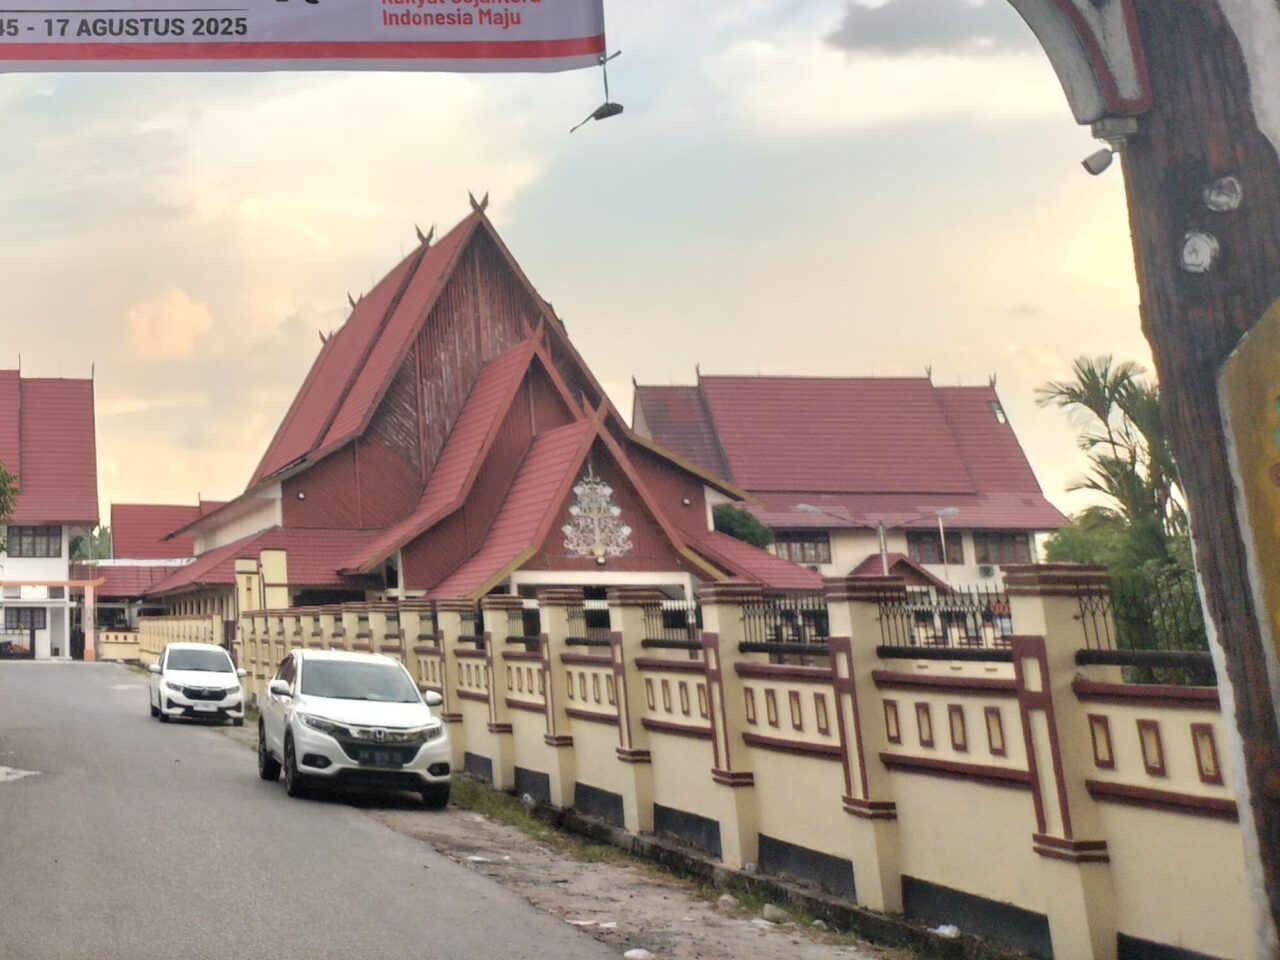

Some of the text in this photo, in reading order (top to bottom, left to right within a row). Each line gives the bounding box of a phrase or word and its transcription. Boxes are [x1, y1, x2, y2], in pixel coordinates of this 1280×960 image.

[44, 18, 70, 37] 17
[76, 17, 186, 37] AGUSTUS
[191, 16, 249, 36] 2025
[382, 8, 522, 30] Indonesia Maju
